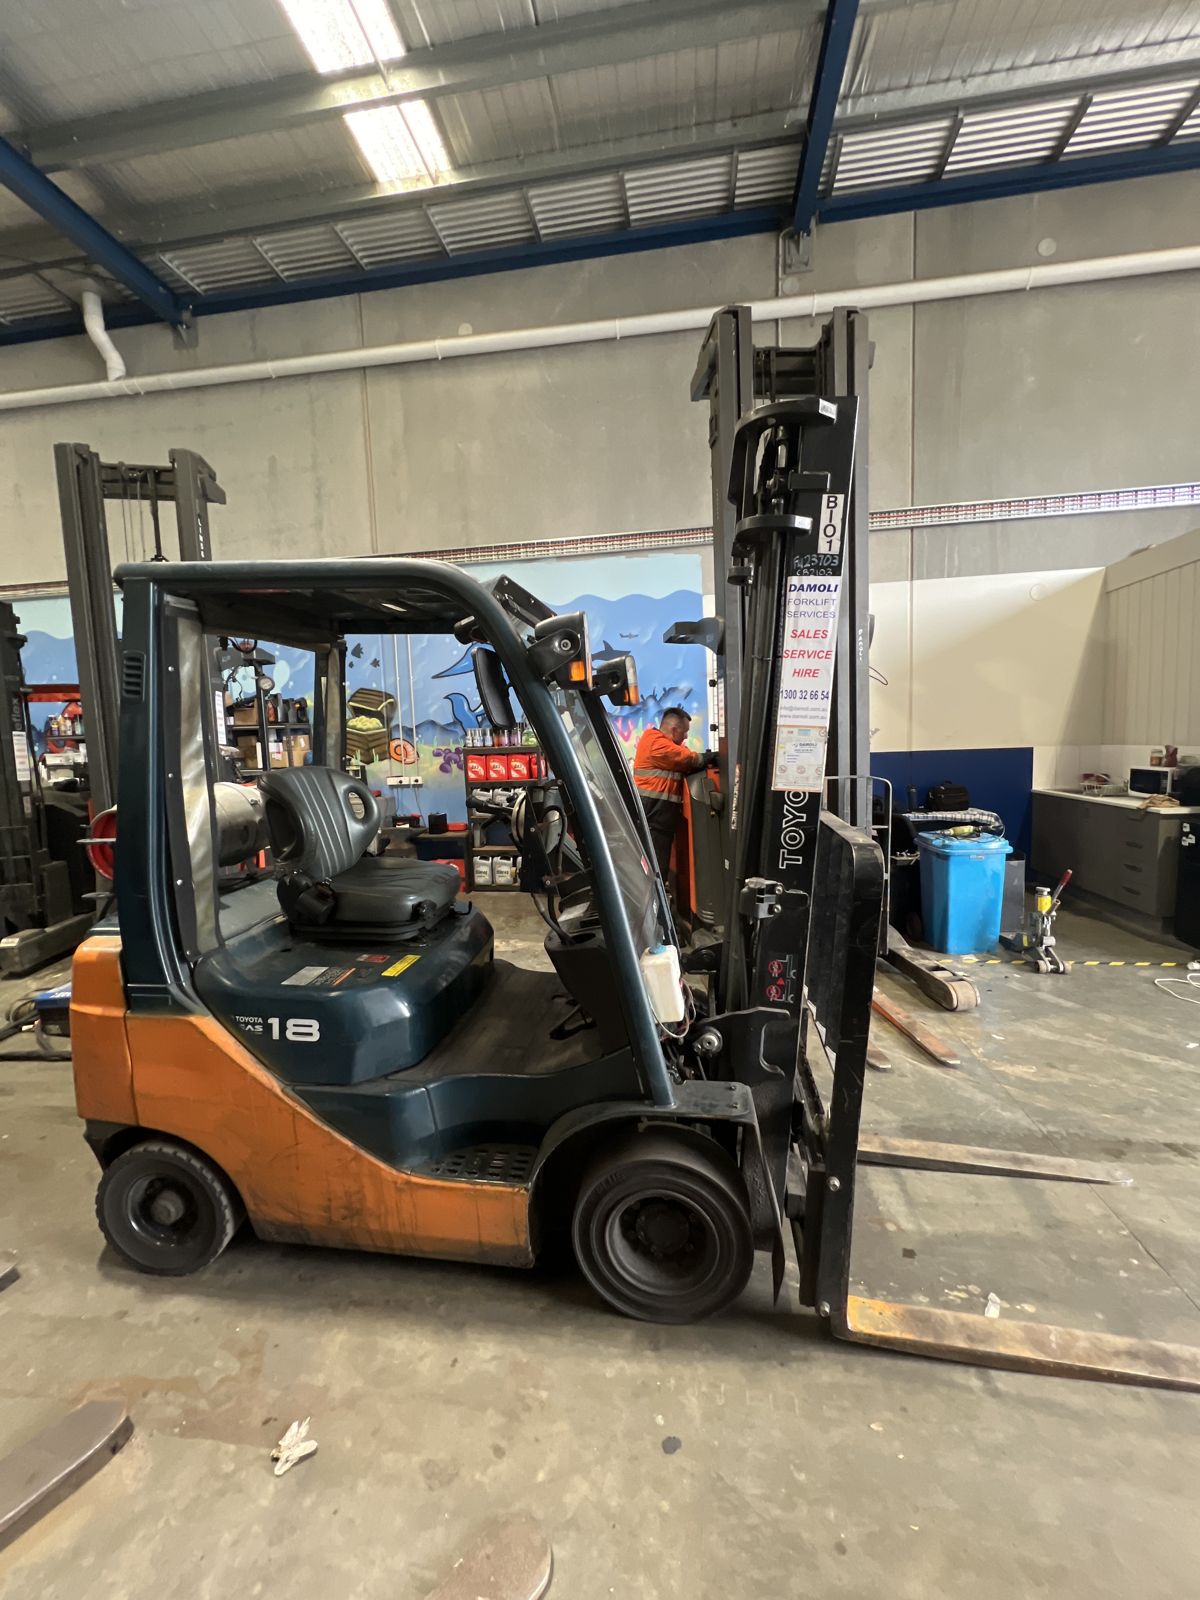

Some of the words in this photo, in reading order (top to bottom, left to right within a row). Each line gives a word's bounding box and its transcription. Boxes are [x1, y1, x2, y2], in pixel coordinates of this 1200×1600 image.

[788, 583, 839, 593] DAMOLI
[787, 598, 837, 606] FORKLIFT
[790, 629, 829, 639] SALES
[783, 649, 833, 660] SERVICE
[792, 668, 821, 678] HIRE
[780, 689, 797, 700] 1300
[799, 689, 808, 700] 32
[809, 690, 819, 700] 66
[820, 690, 830, 700] 54
[12, 697, 23, 731] eflex
[779, 791, 808, 868] TOYO
[235, 1015, 264, 1024] TOYOTA
[267, 1017, 321, 1042] 18
